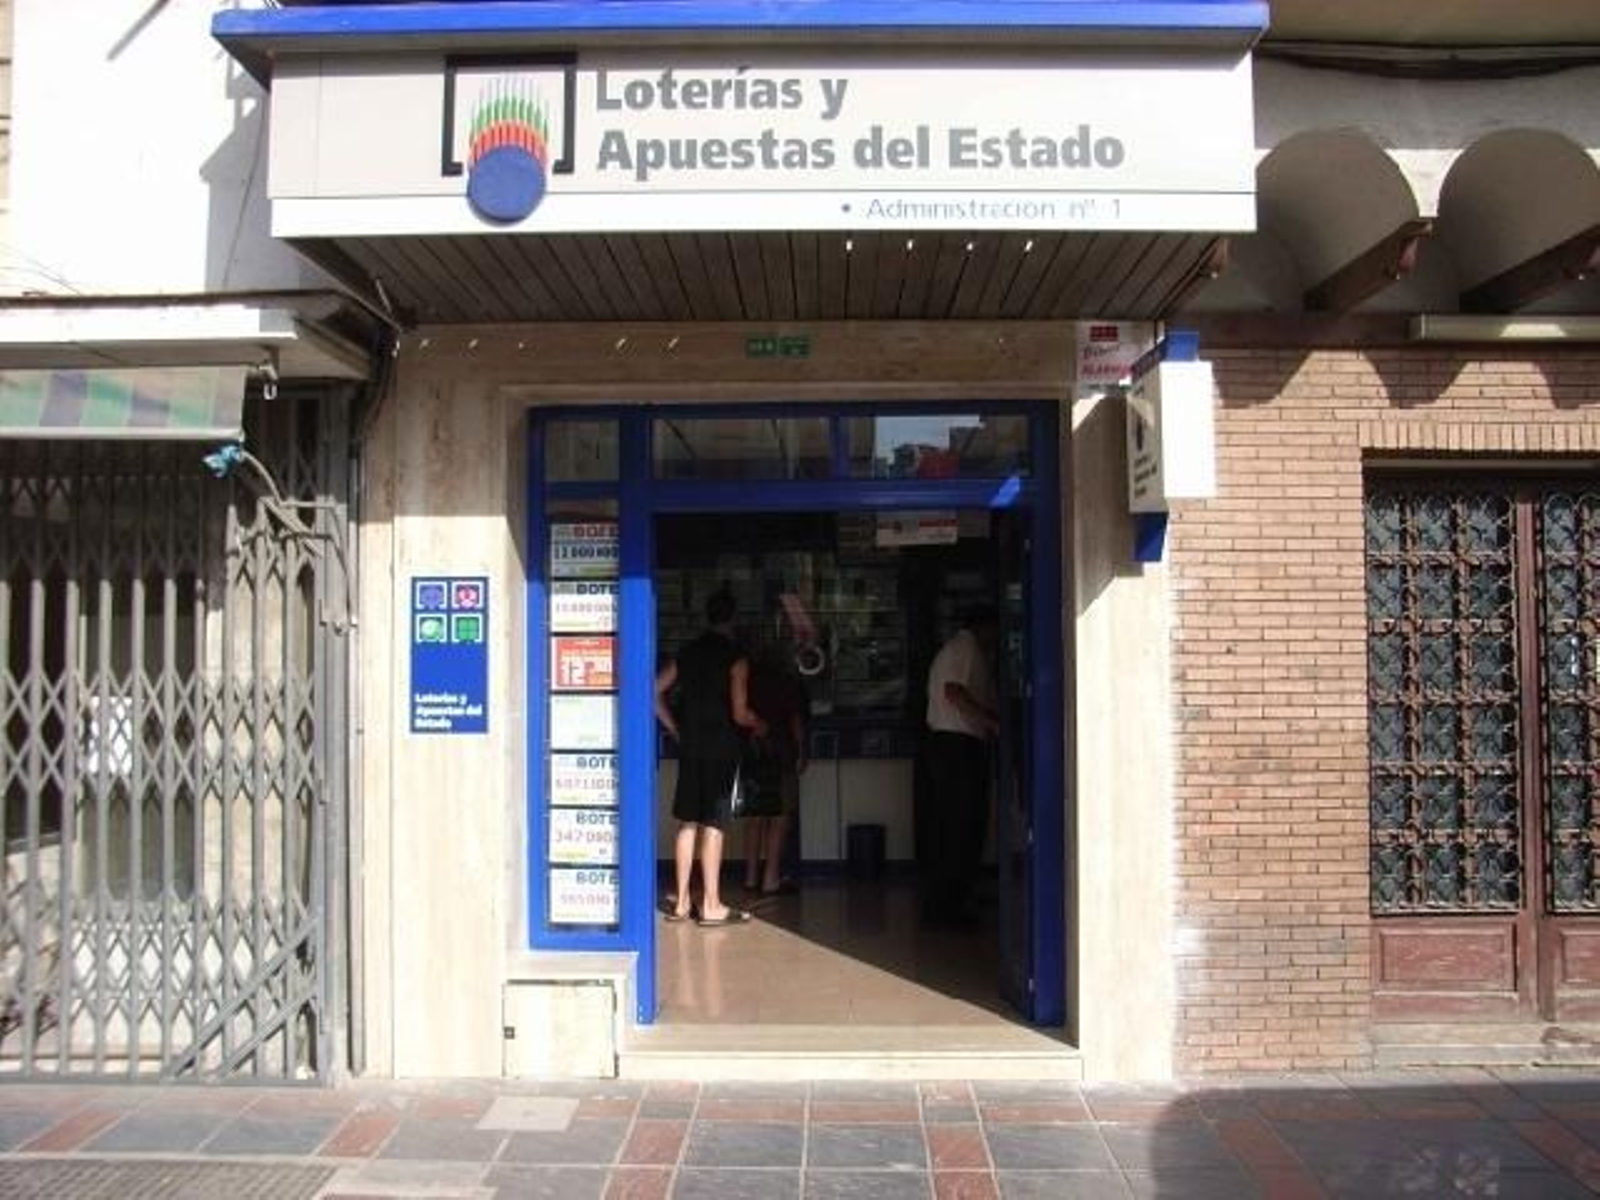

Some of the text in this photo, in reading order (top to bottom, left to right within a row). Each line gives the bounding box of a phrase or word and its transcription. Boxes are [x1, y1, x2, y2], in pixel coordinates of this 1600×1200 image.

[597, 66, 848, 120] Loterías y
[597, 124, 1125, 181] Apuestas del Estado
[576, 812, 619, 825] BOTE
[576, 871, 619, 885] BOTE
